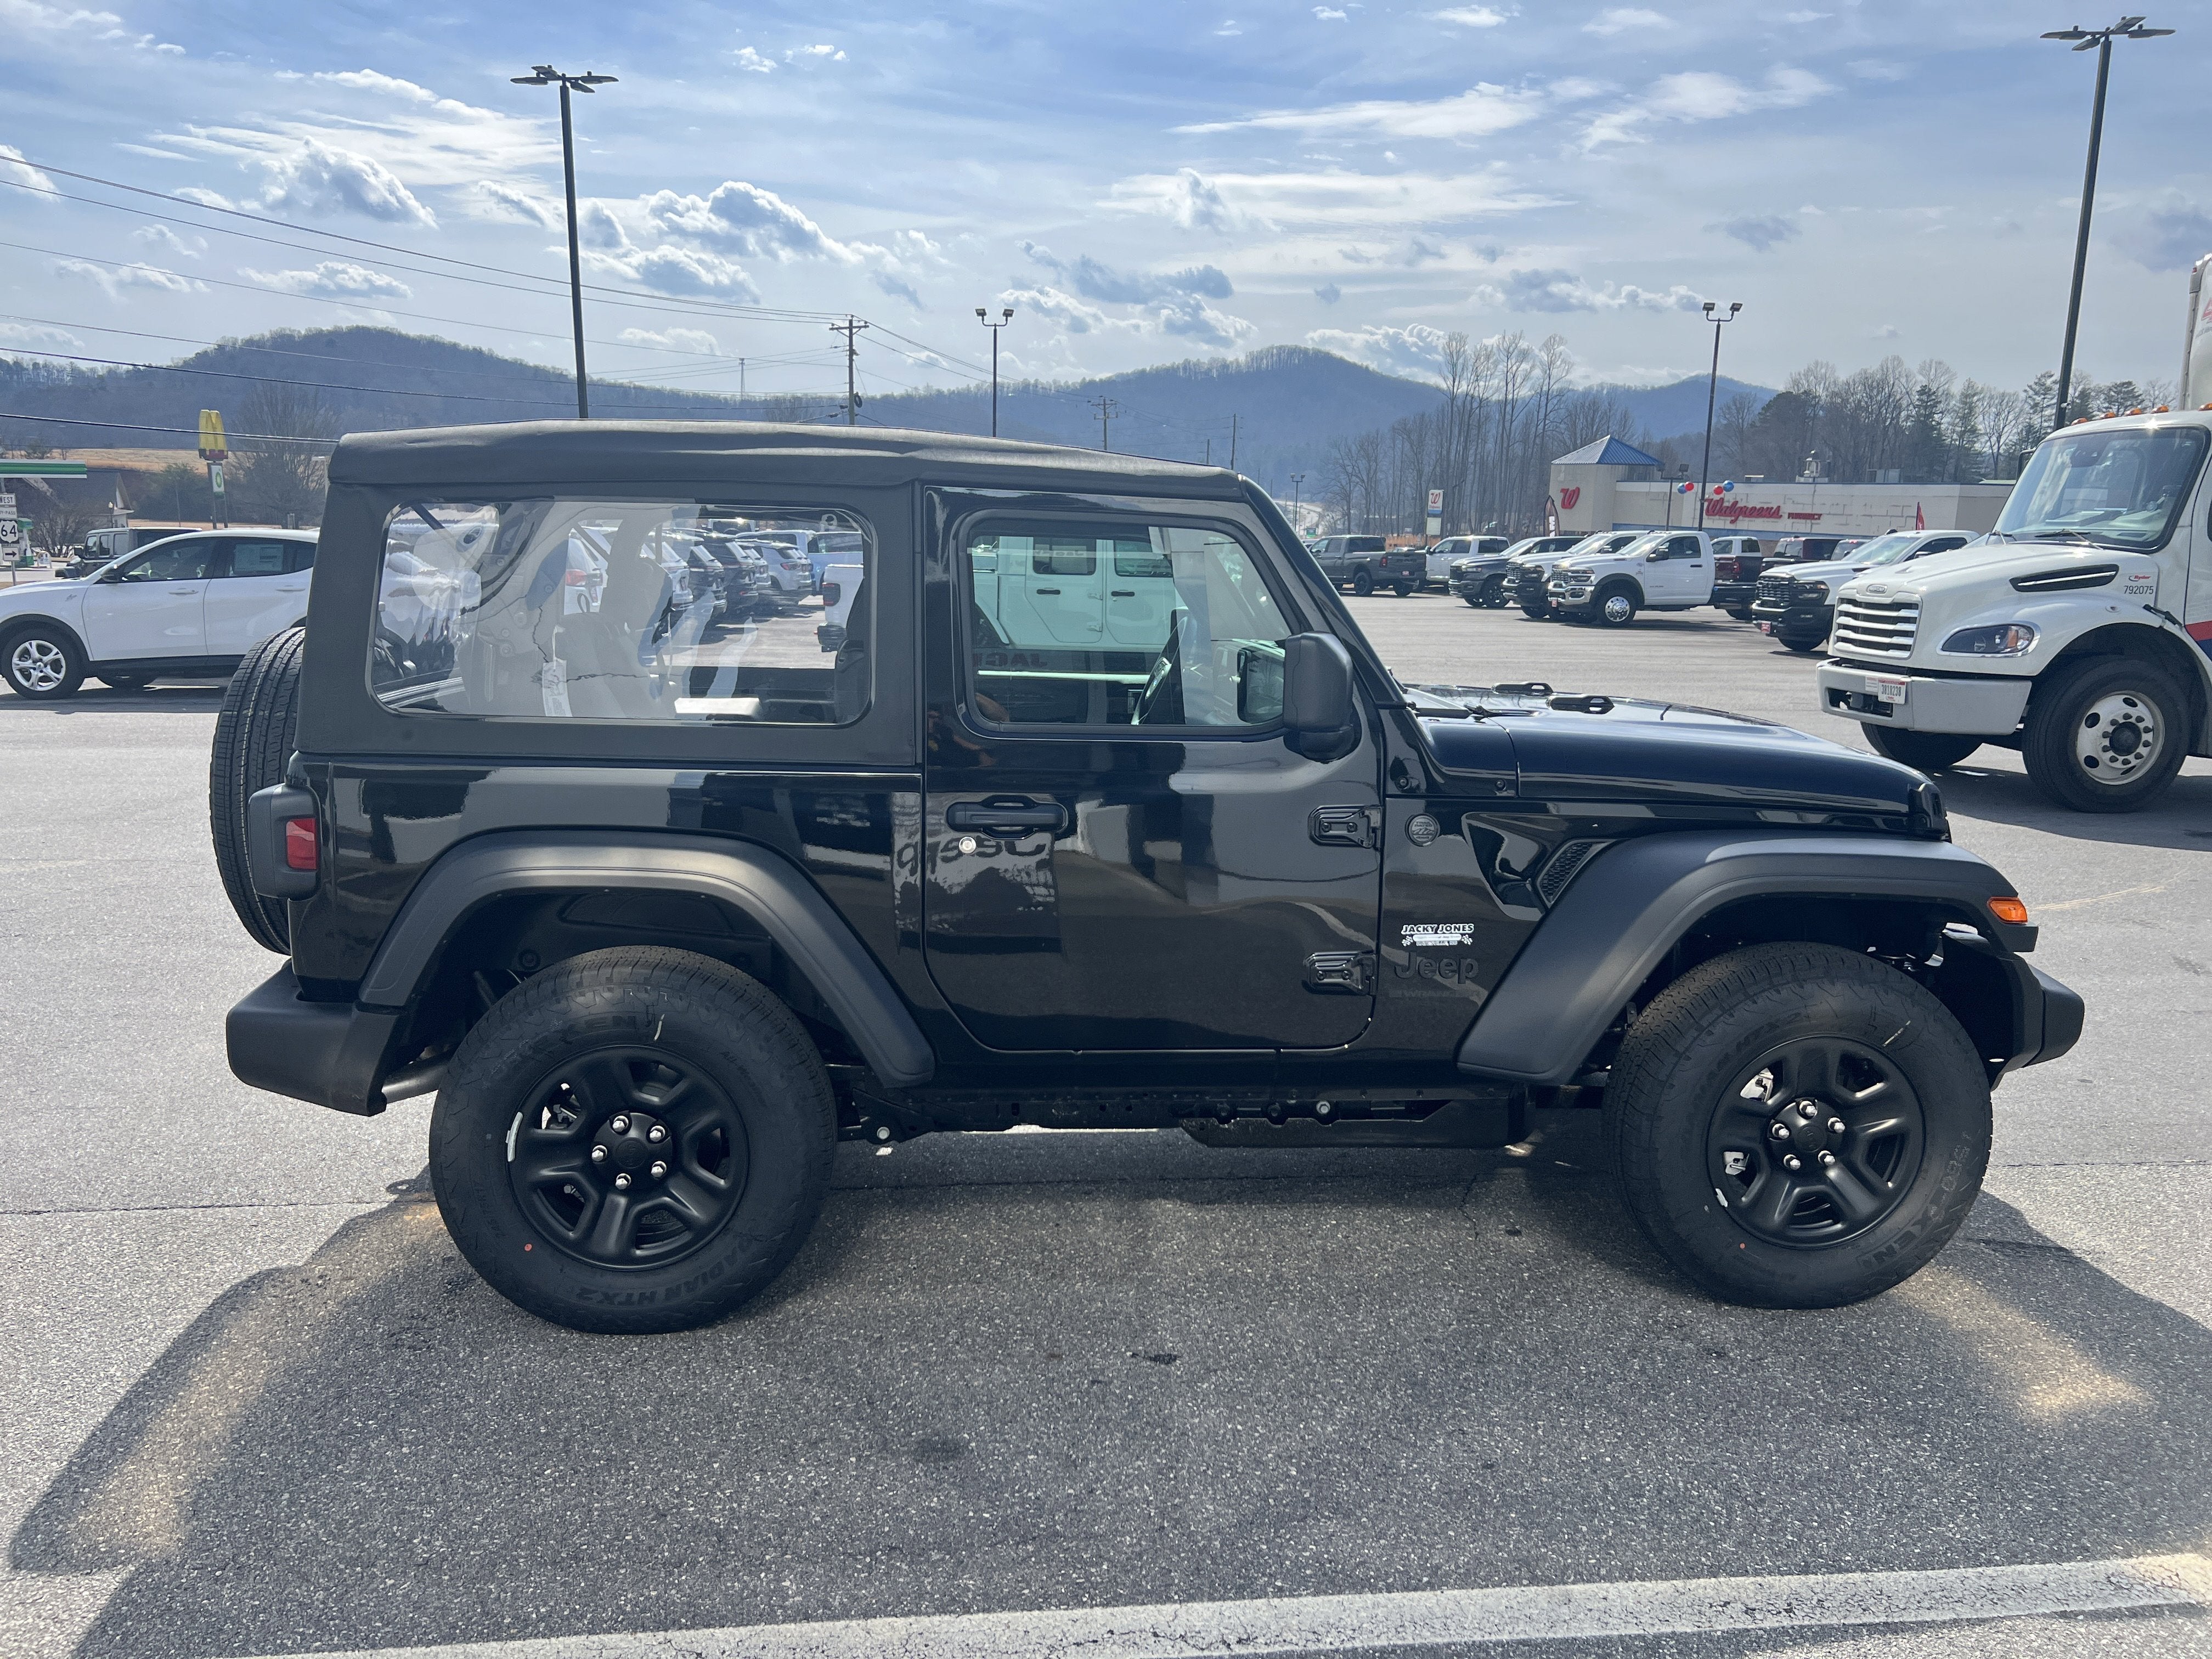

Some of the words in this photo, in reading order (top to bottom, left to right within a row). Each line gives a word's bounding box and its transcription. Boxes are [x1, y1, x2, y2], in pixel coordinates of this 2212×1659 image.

[1430, 492, 1441, 504] W
[1560, 487, 1581, 509] W
[1704, 497, 1782, 524] Walgreens
[1, 524, 16, 537] 64
[2124, 585, 2154, 595] 792075
[1881, 684, 1901, 697] 3818238
[1401, 924, 1437, 934] JACKY
[1437, 924, 1474, 933] JONES
[1394, 952, 1479, 984] Jeep
[576, 1285, 659, 1306] HTX2
